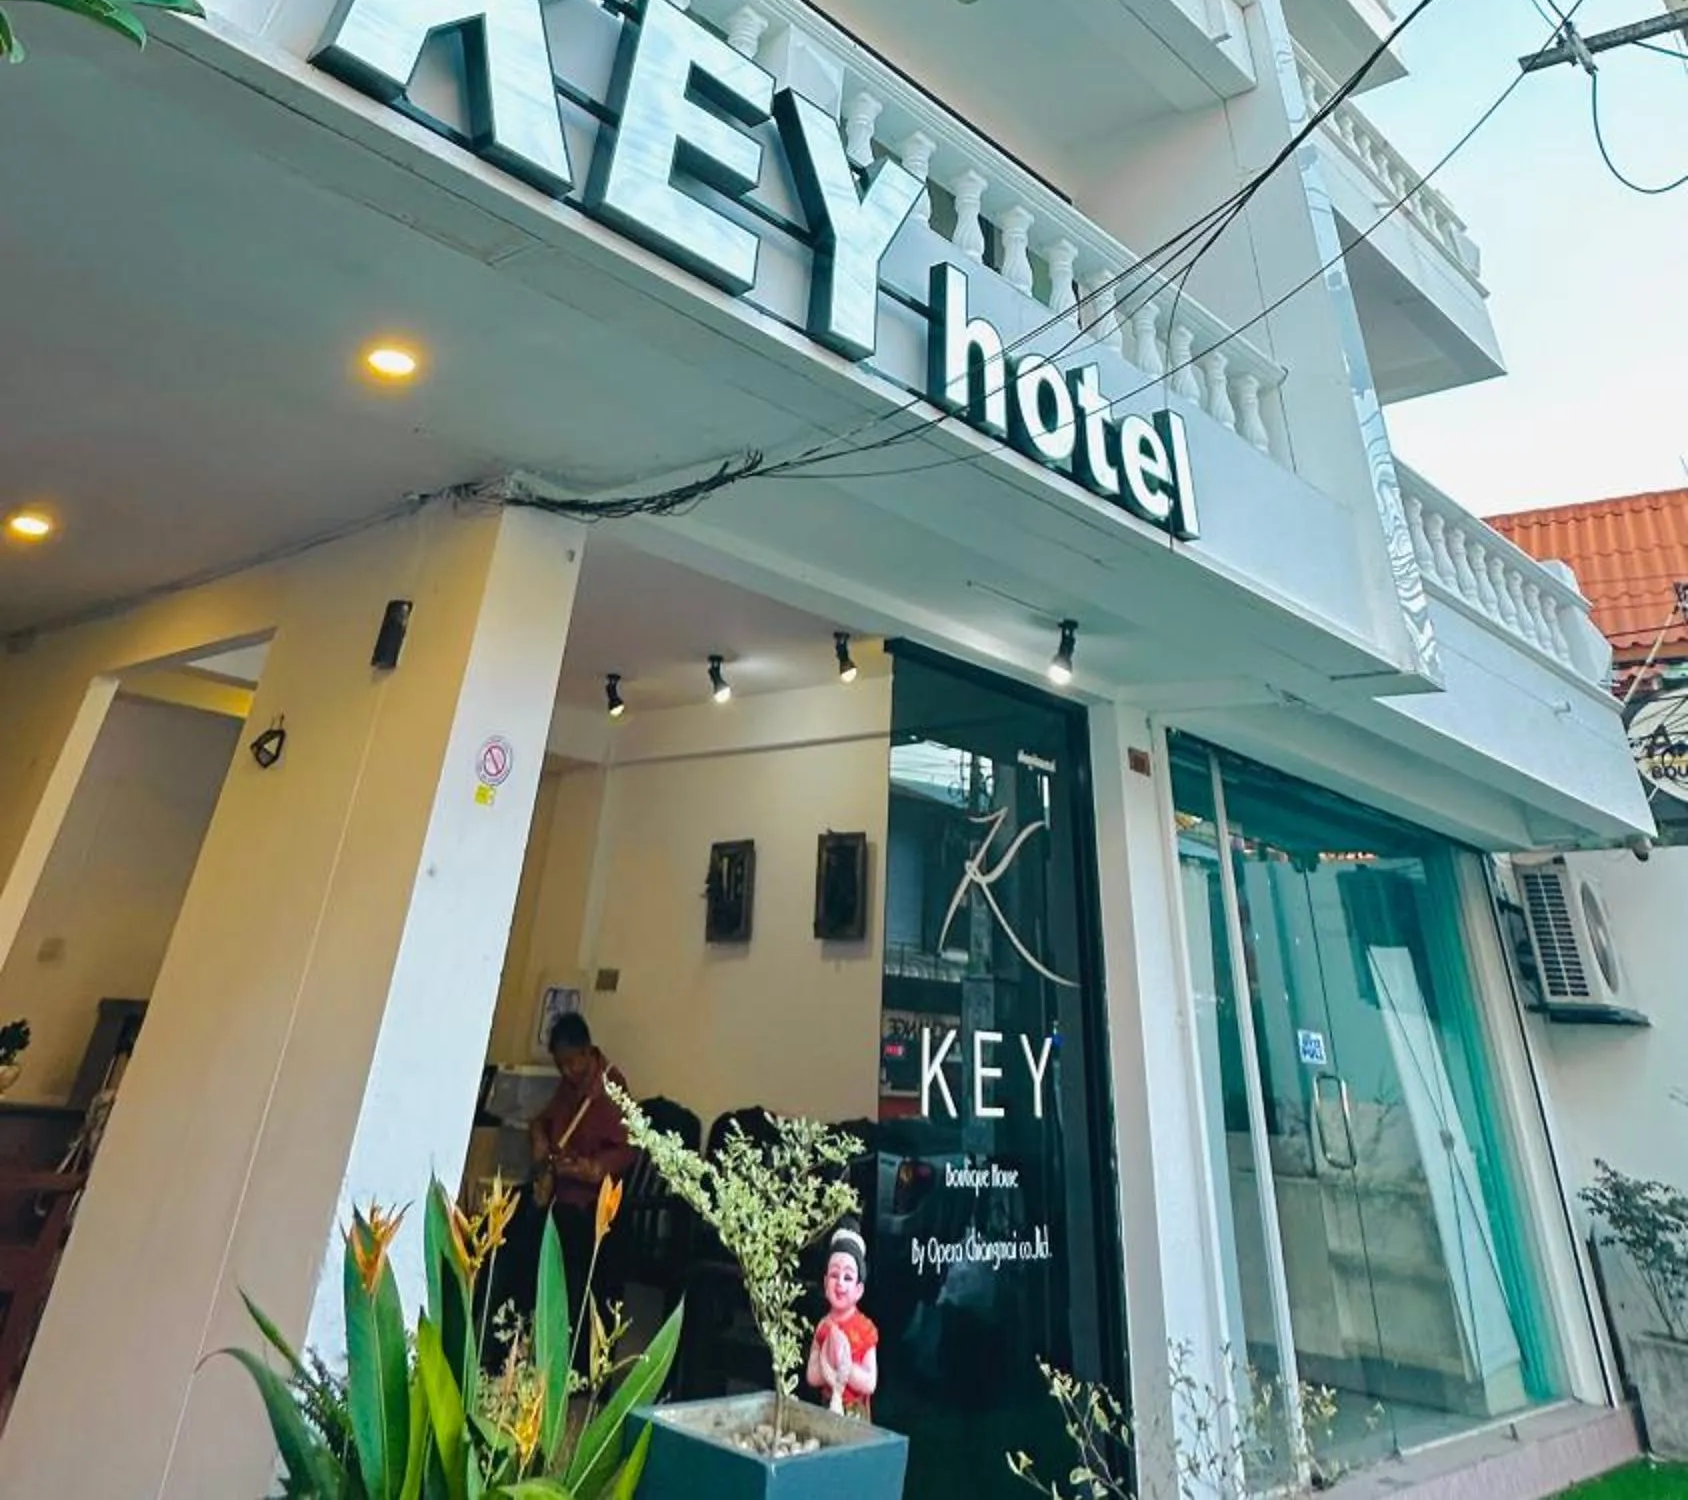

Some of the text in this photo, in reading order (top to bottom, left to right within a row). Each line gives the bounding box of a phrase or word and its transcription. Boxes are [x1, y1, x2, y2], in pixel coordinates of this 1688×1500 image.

[931, 262, 1200, 540] hotel
[921, 1027, 1053, 1119] KEY
[911, 1237, 925, 1276] By
[927, 1237, 963, 1275] Opera
